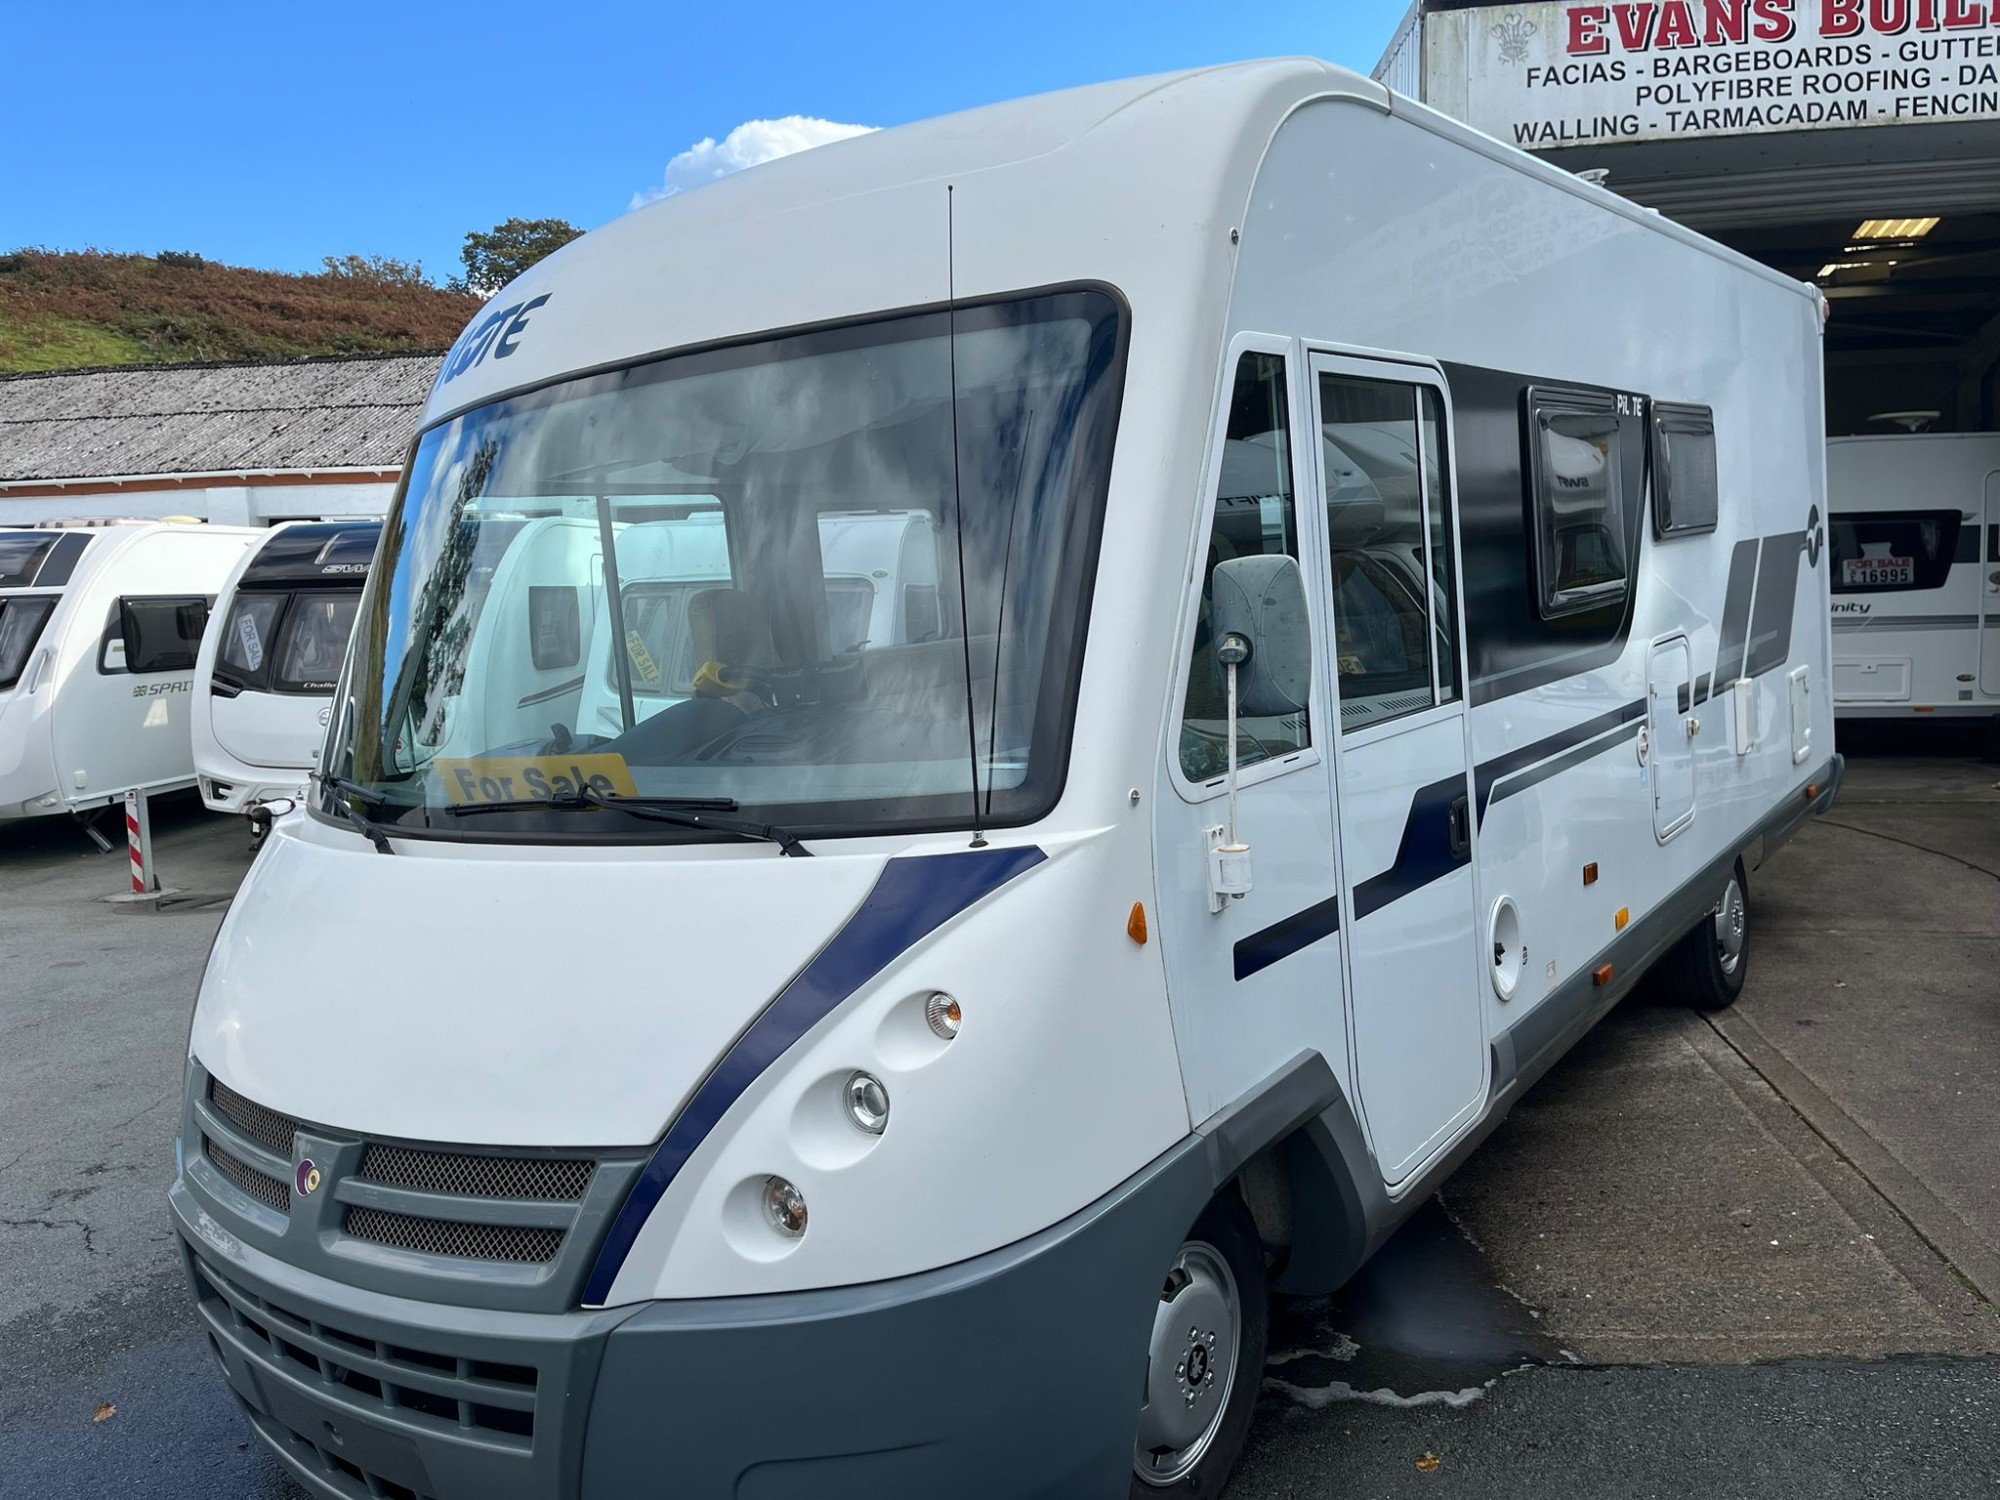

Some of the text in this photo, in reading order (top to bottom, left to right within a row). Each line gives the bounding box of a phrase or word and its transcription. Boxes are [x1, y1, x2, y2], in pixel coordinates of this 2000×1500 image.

[1566, 0, 2000, 56] EVANS BUIL
[1527, 61, 1626, 88] FACIAS
[1653, 44, 1872, 79] BARGEBOARDS
[1899, 35, 2000, 62] GUTTE
[1636, 76, 1793, 106] POLYFIBRE
[1803, 67, 1931, 96] ROOFING
[1958, 63, 1998, 86] DA
[1513, 114, 1640, 144] WALLING
[1666, 99, 1868, 132] TARMACADAM
[1895, 91, 1998, 118] FENCIN
[241, 619, 256, 643] FOR
[454, 766, 614, 802] For Sale
